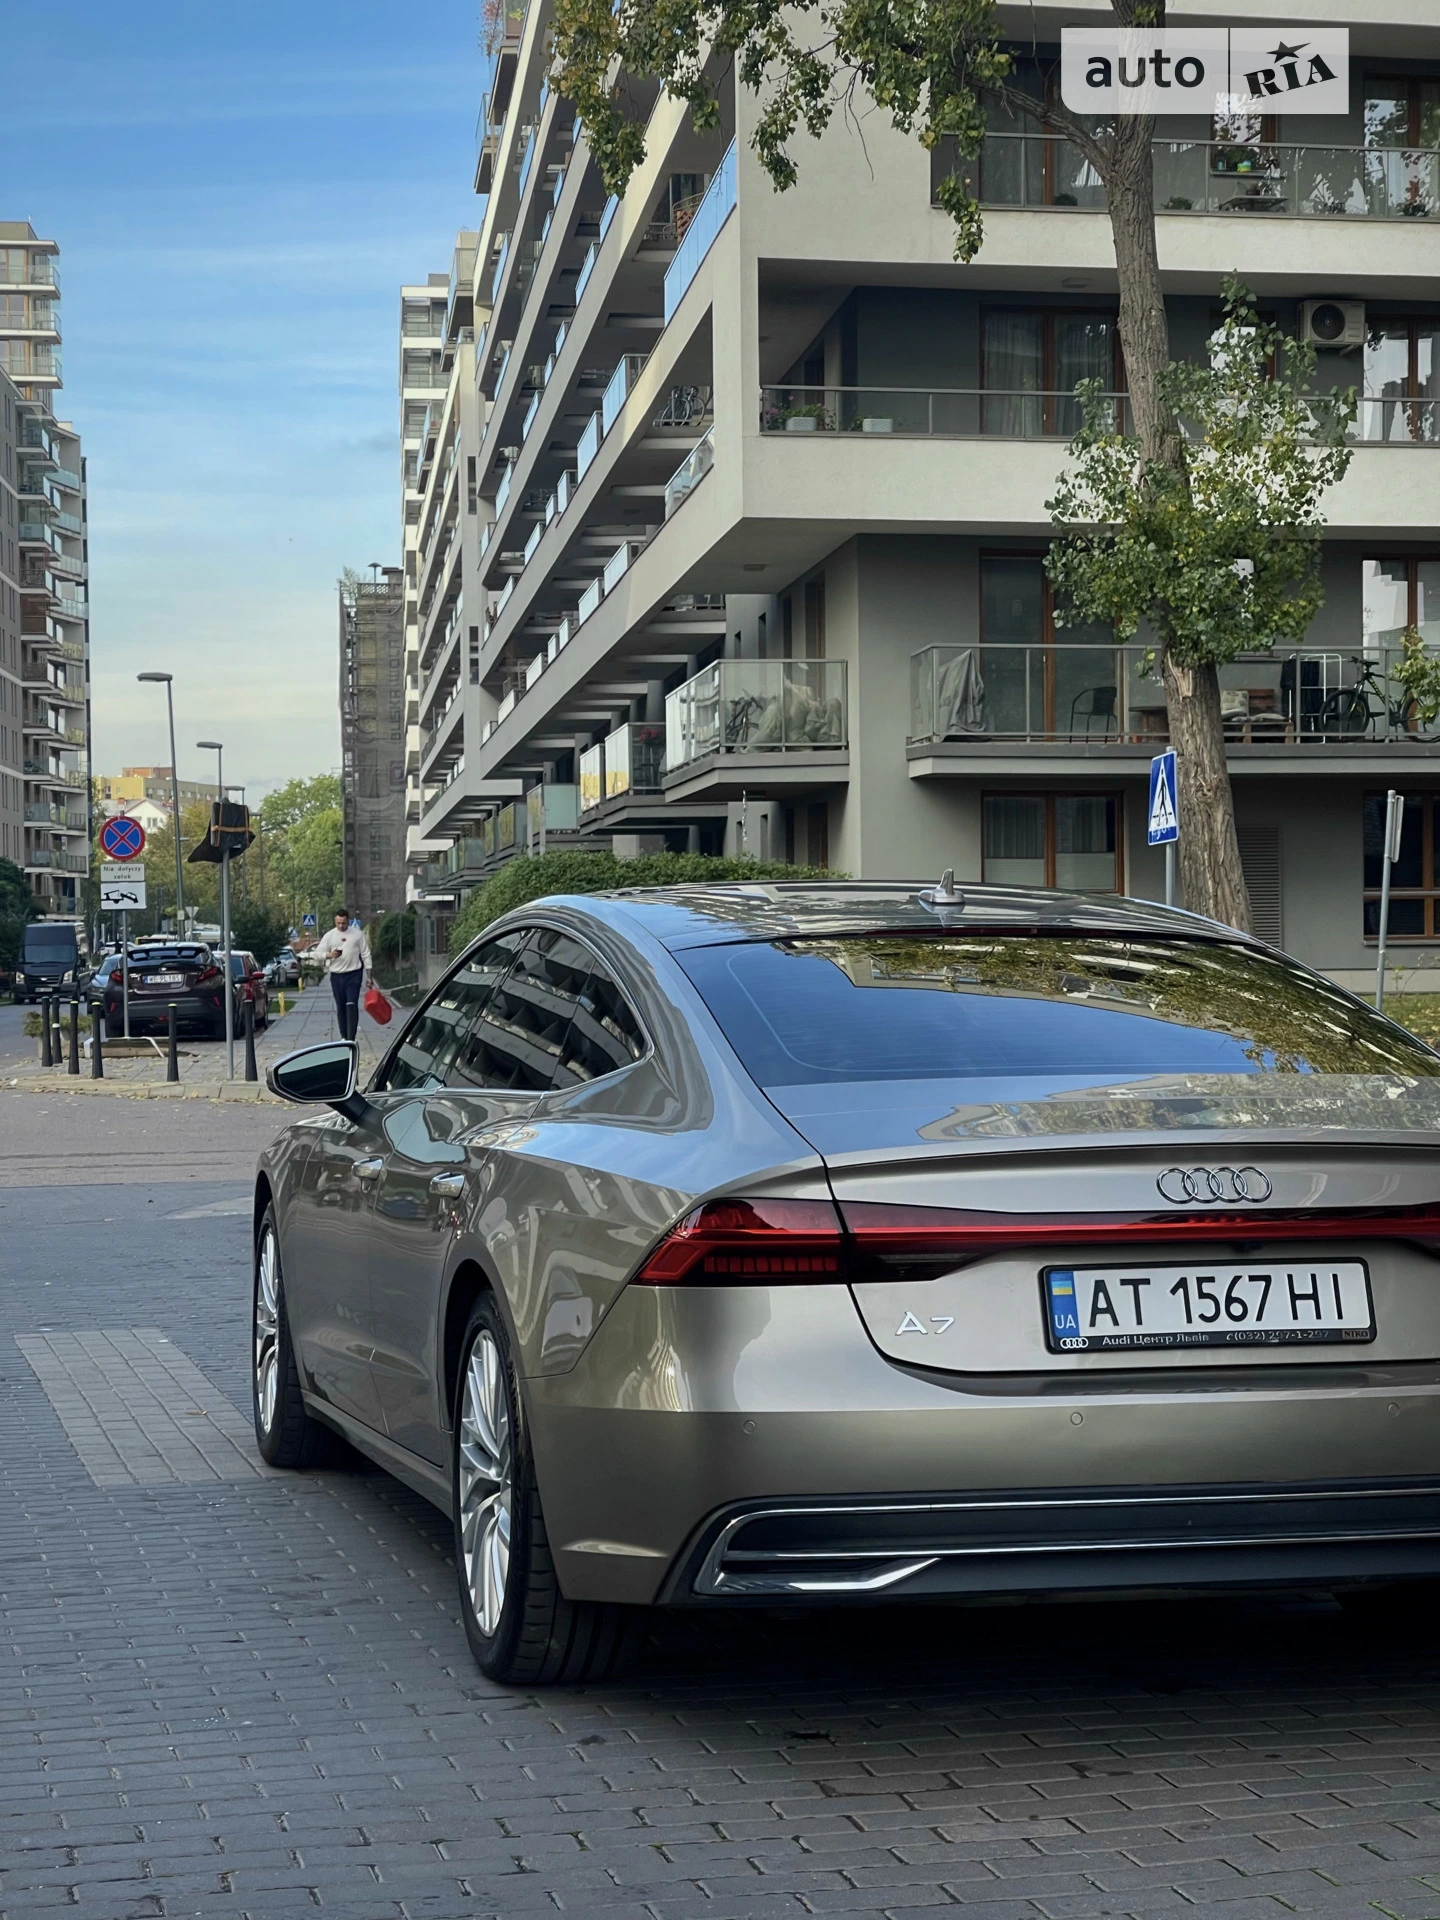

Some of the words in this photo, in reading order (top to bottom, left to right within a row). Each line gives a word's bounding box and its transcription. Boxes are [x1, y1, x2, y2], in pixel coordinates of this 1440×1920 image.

[1089, 1278, 1151, 1328] AT
[1169, 1275, 1272, 1325] 1567
[1286, 1273, 1344, 1321] HI
[894, 1311, 955, 1336] A7
[1055, 1314, 1077, 1330] UA
[1102, 1335, 1131, 1346] Audi
[1133, 1334, 1173, 1346] Центр
[1176, 1333, 1210, 1343] Львів
[1234, 1331, 1266, 1341] (032)
[1268, 1330, 1329, 1341] 297-1-297
[1344, 1330, 1369, 1338] NIKO
